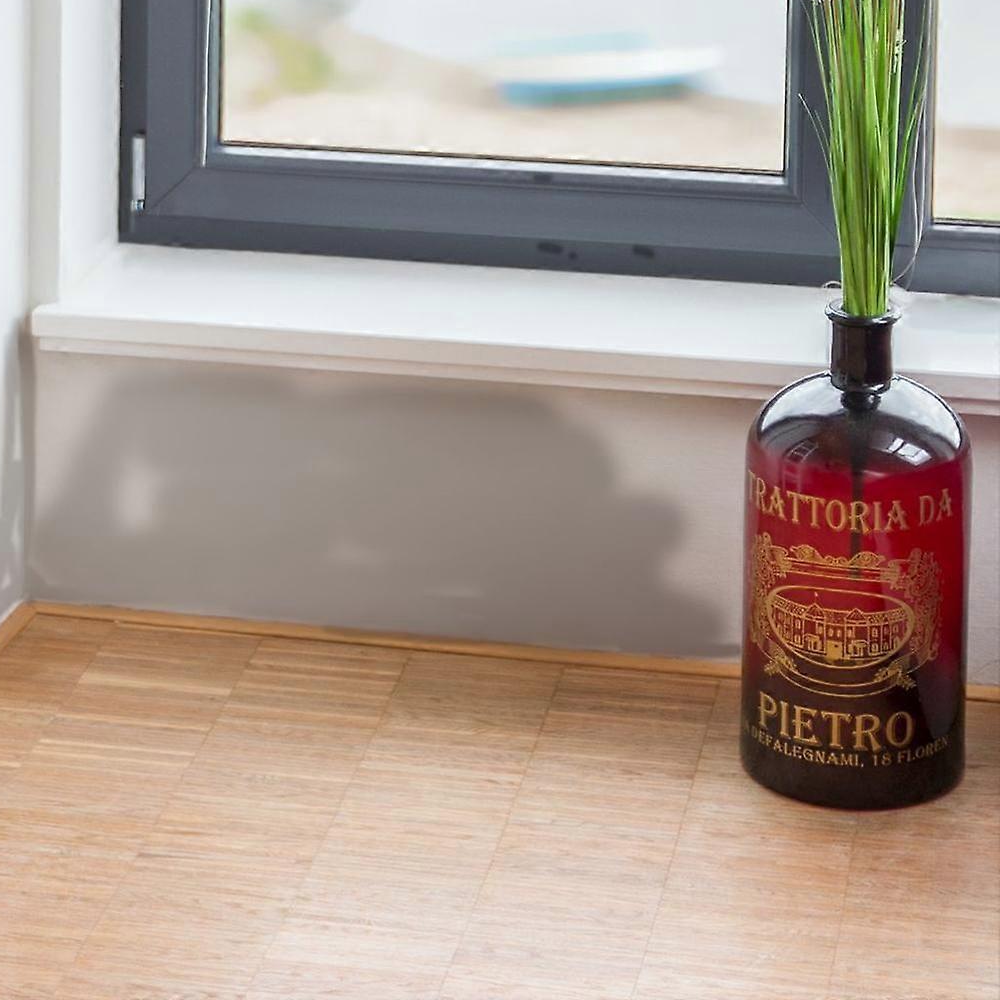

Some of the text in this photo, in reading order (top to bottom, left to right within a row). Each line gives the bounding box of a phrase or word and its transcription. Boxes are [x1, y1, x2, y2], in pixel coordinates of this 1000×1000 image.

[748, 469, 953, 534] TRATTORIA DA
[758, 691, 916, 753] PIETRO
[873, 751, 893, 766] 18
